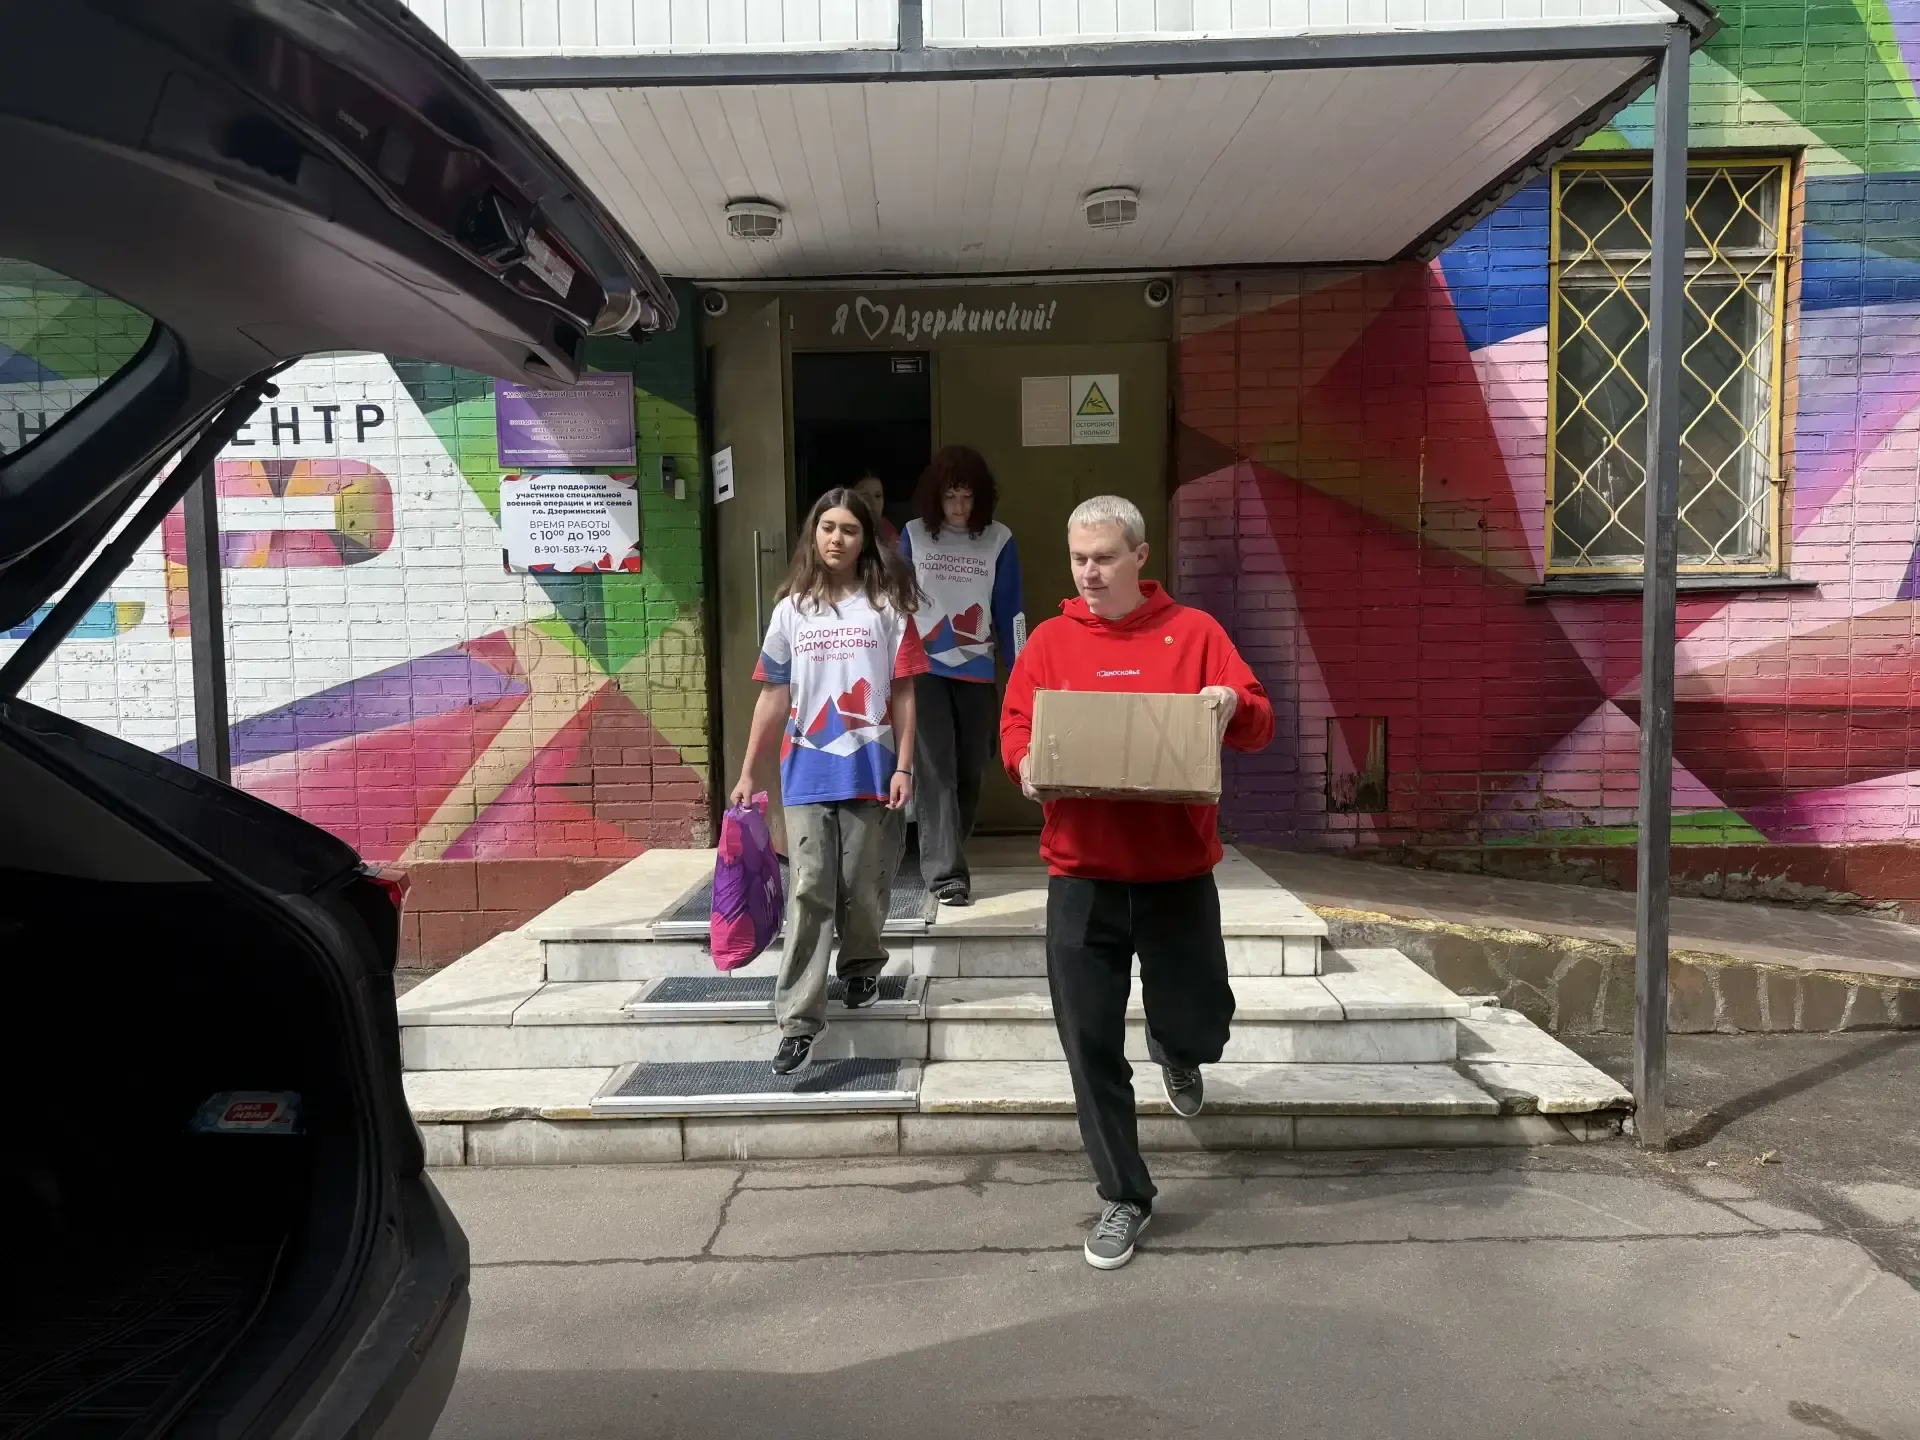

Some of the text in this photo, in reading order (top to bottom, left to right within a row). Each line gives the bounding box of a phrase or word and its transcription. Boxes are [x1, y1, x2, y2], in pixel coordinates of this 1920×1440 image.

[831, 299, 1057, 343] Я Дзержинский!
[231, 404, 385, 446] ЕНТР
[530, 484, 607, 492] Центр поддержки
[516, 491, 622, 500] участников специальной
[506, 499, 542, 507] военной
[606, 499, 633, 507] семей
[547, 508, 607, 516] Дзержинский
[529, 520, 610, 529] ВРЕМЯ РАБОТЫ
[567, 532, 584, 542] до
[534, 545, 608, 554] 8-901-583-74-12
[925, 552, 986, 567] ВОЛОНТЕРЫ
[919, 562, 989, 578] ПОДМОСКОВЬЯ
[935, 573, 973, 584] МЫ РЯДОМ
[811, 652, 855, 662] МЫ РЯДОМ
